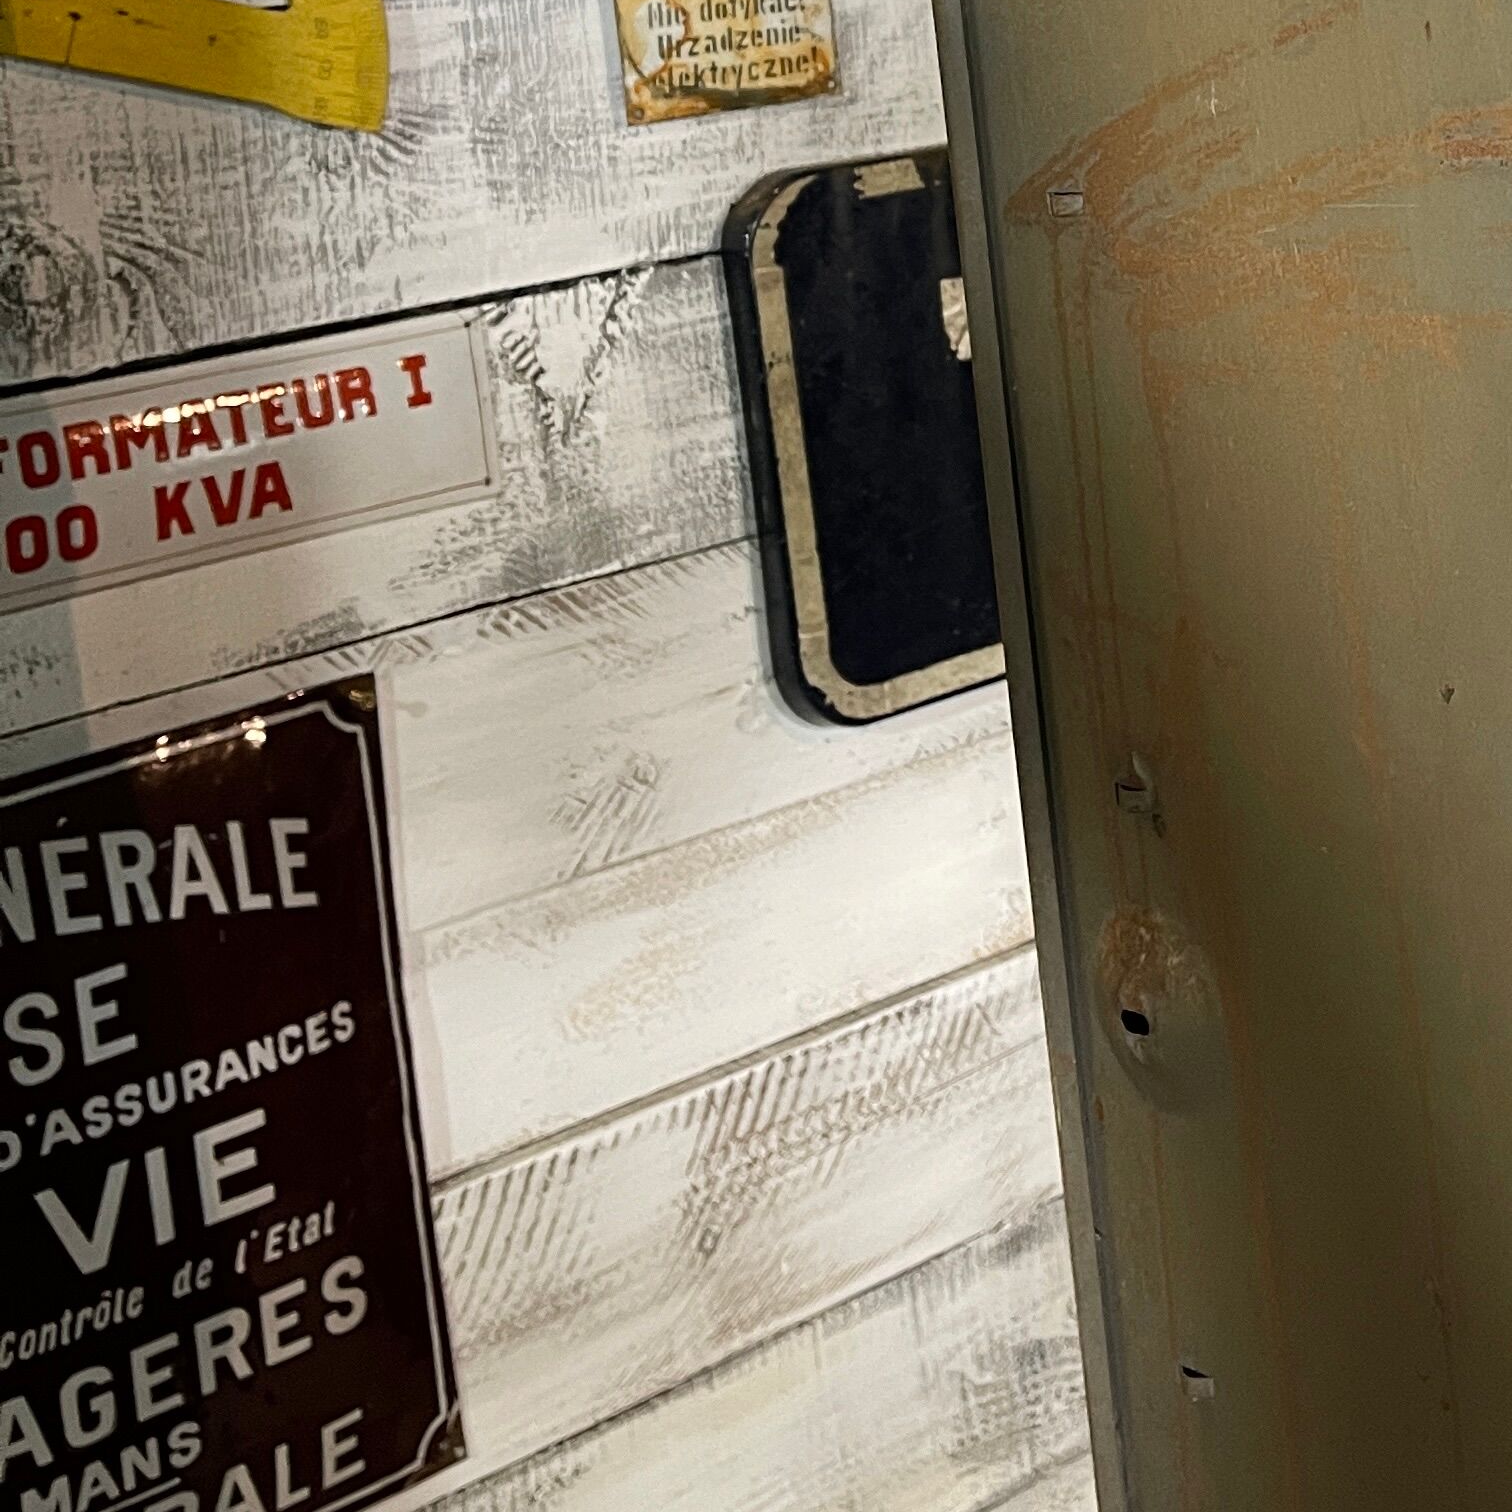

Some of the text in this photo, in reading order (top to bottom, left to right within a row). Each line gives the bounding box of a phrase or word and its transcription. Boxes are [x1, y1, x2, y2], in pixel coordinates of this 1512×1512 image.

[397, 354, 432, 409] I
[152, 460, 294, 542] KVA
[3, 962, 138, 1086] SE
[0, 999, 356, 1172] D'ASSURANCES
[34, 1107, 276, 1275] VIE
[172, 1258, 213, 1300] de
[20, 1420, 201, 1512] MANS
[143, 1407, 366, 1512] ALE
